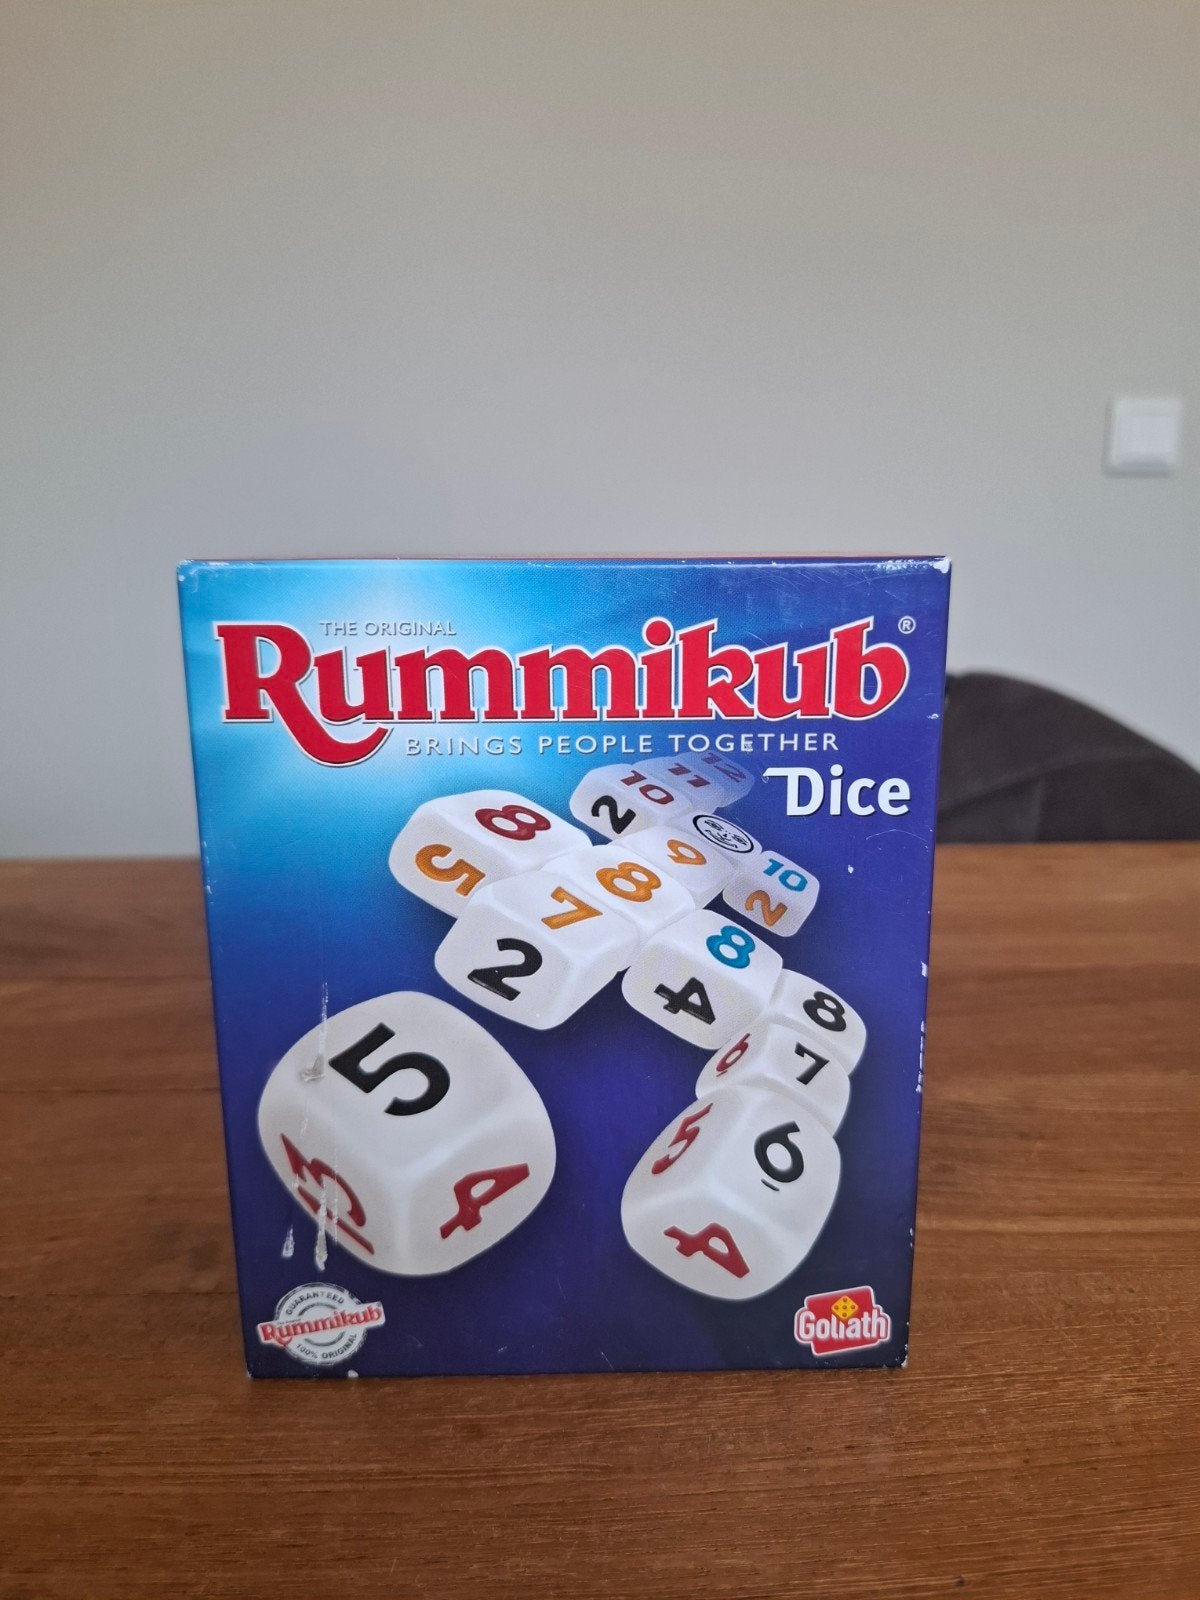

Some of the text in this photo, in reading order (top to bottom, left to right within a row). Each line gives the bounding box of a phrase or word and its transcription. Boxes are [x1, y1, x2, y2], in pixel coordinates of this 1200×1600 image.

[320, 621, 457, 636] THE ORIGINAL
[213, 616, 911, 767] Rummikub
[406, 733, 839, 756] BRINGS PEOPLE TOGETHER
[620, 770, 675, 805] 10
[667, 762, 711, 788] 11
[702, 752, 747, 783] 12
[762, 763, 912, 817] Dice
[474, 804, 552, 841] 8
[591, 795, 636, 834] 2
[415, 843, 487, 897] 5
[595, 861, 662, 903] 8
[763, 857, 808, 892] 10
[541, 886, 603, 930] 7
[745, 890, 788, 926] 2
[705, 925, 756, 969] 8
[467, 937, 543, 1002] 2
[654, 976, 716, 1025] 4
[803, 991, 847, 1032] 8
[328, 1022, 451, 1117] 5
[794, 1041, 830, 1086] 7
[651, 1102, 714, 1175] 5
[753, 1120, 805, 1192] 6
[439, 1162, 531, 1240] 4
[663, 1222, 751, 1279] 4
[285, 1290, 344, 1315] GUARANTEED
[260, 1304, 382, 1347] Rummikub
[798, 1308, 887, 1340] Goliath
[321, 1332, 358, 1360] ORIGINAL
